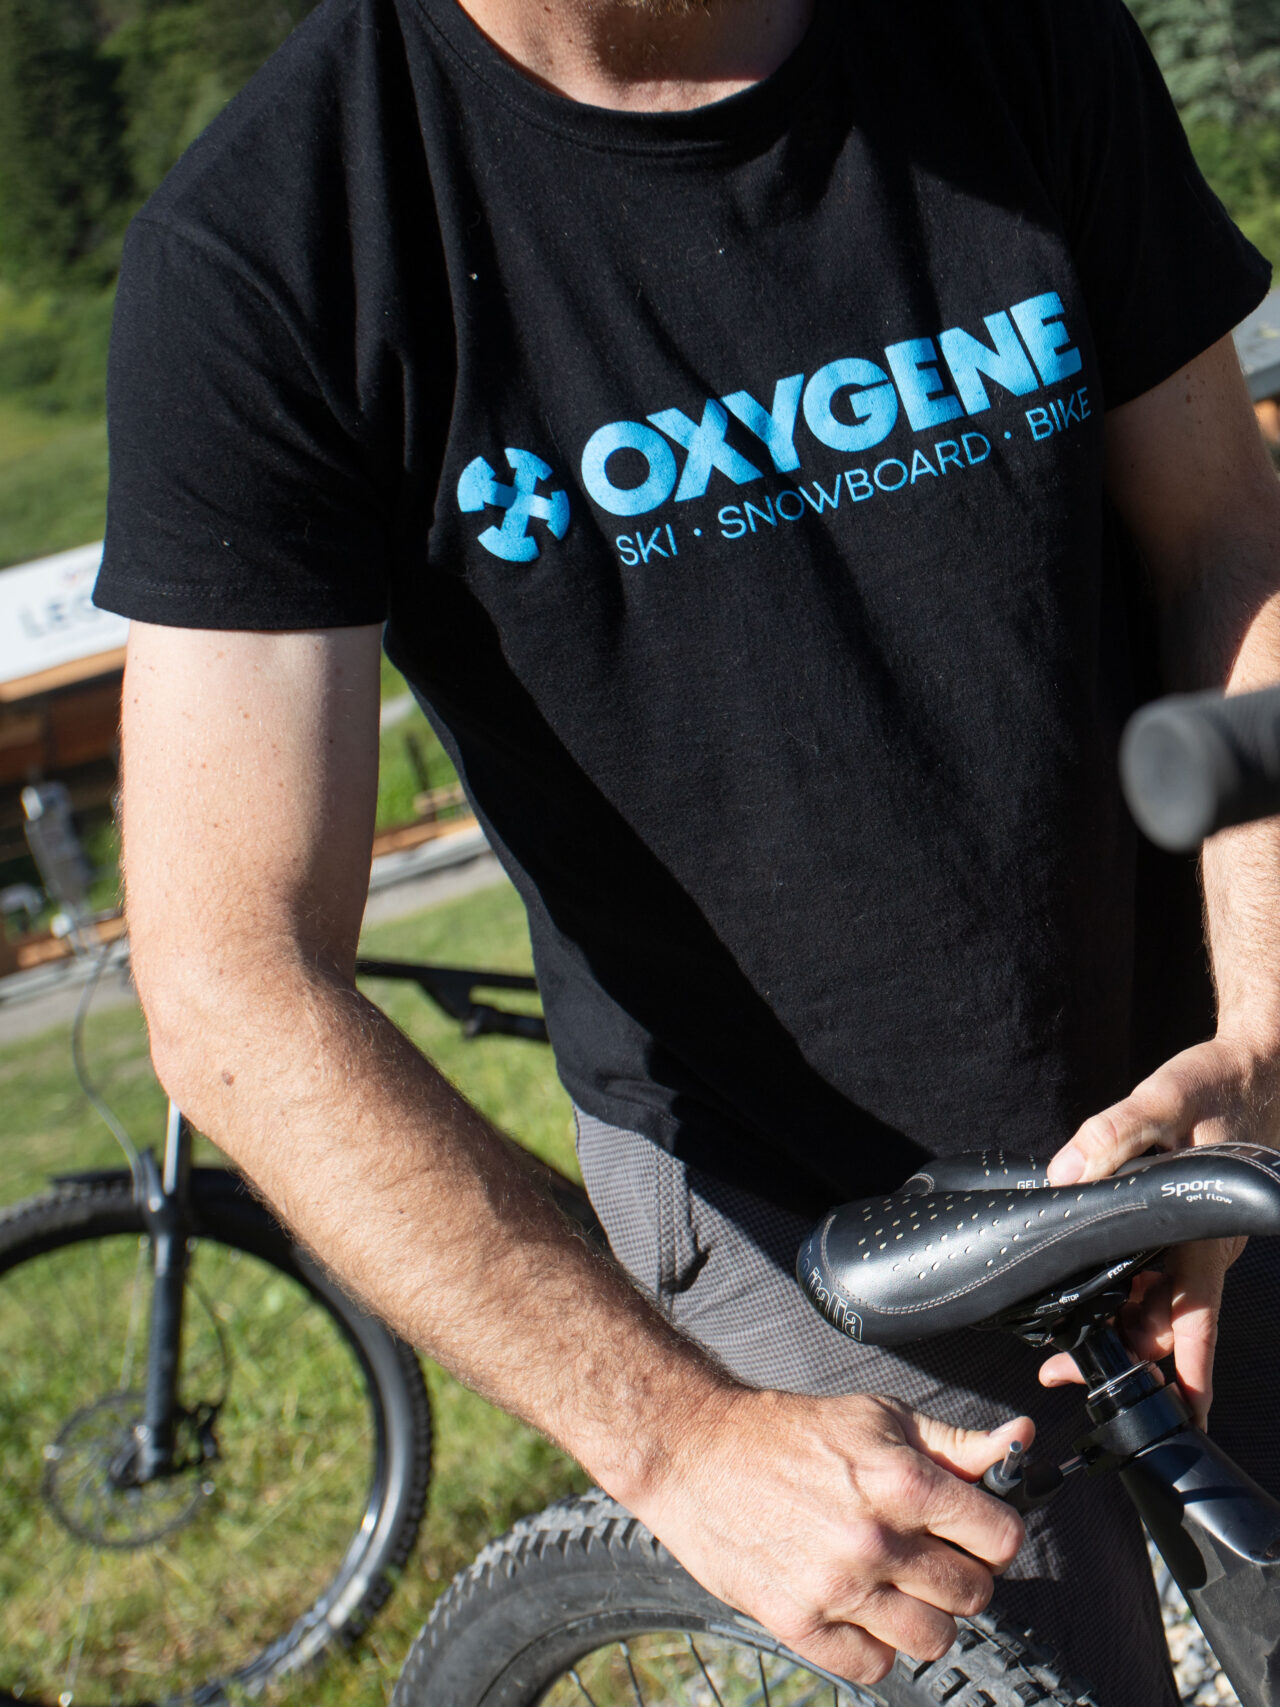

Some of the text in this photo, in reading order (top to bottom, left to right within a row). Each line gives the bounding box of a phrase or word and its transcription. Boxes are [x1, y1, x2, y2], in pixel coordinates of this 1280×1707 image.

[581, 291, 1082, 516] OXYGENE
[615, 386, 1092, 566] SKI SNOWBOARD BIKE
[1017, 1179, 1040, 1190] GEL
[1186, 1193, 1202, 1203] gel
